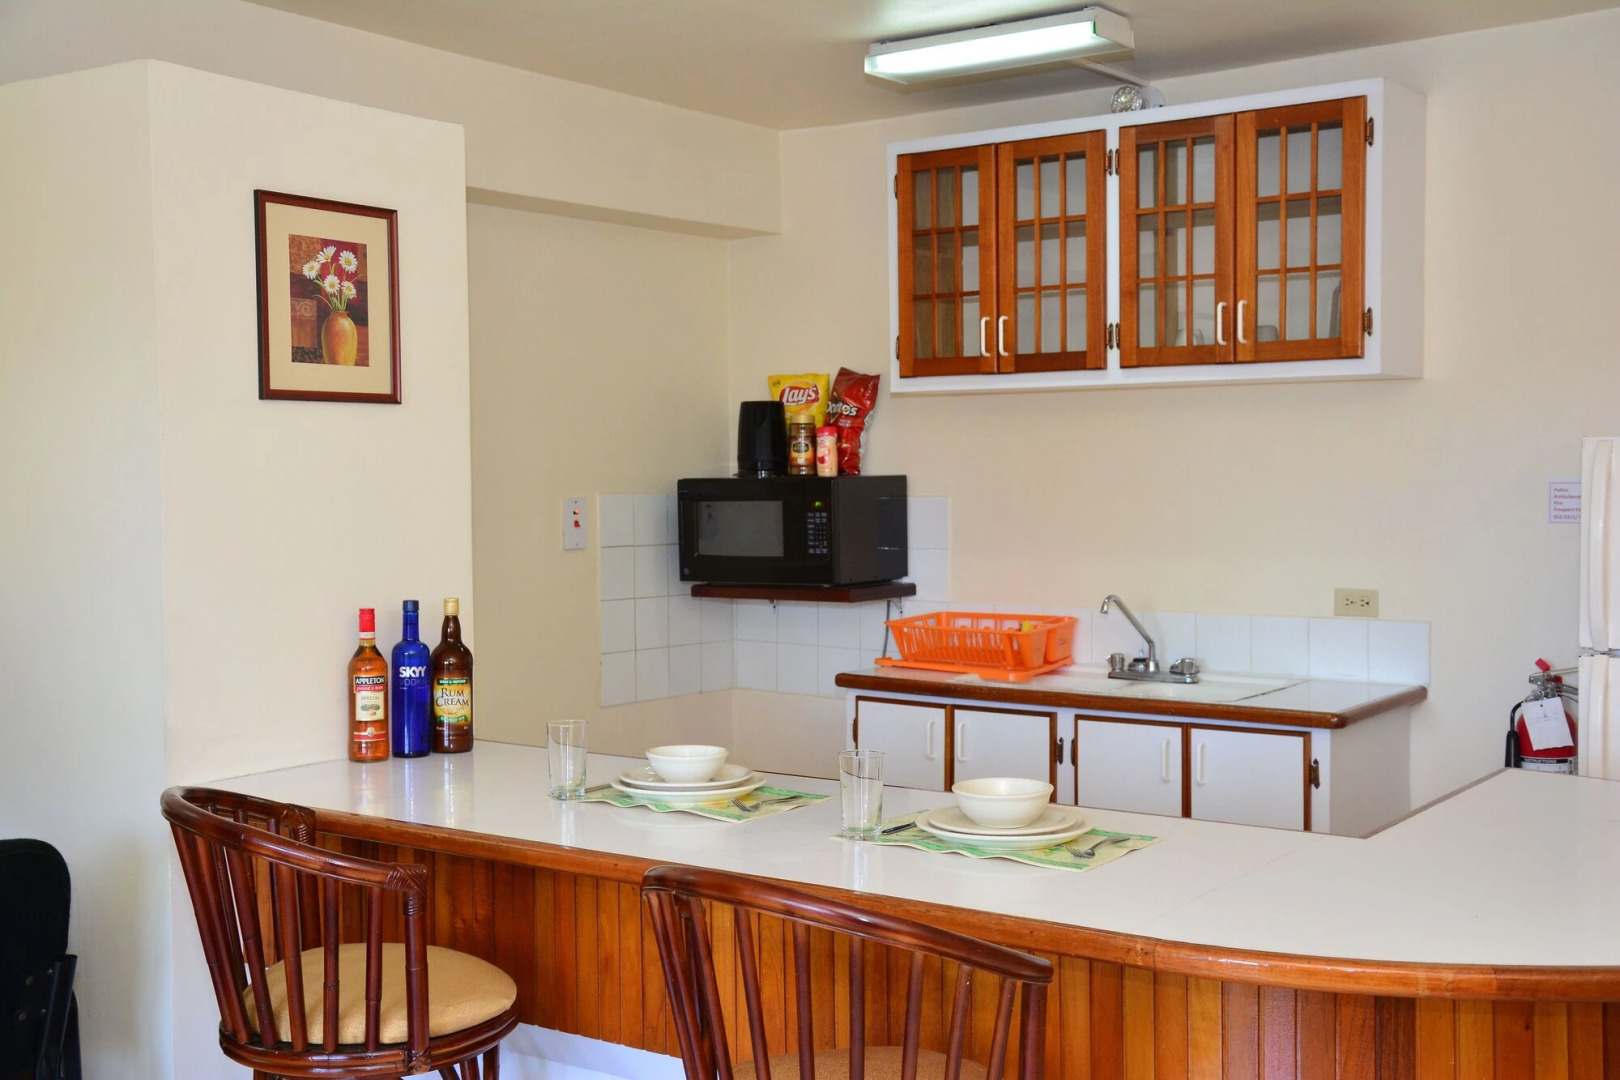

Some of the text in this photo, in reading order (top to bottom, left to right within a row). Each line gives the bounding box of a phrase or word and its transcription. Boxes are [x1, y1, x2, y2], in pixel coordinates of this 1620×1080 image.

[399, 666, 427, 678] SKYY
[355, 677, 385, 685] APPLETON
[441, 687, 465, 697] RUM
[435, 697, 469, 707] CREAM
